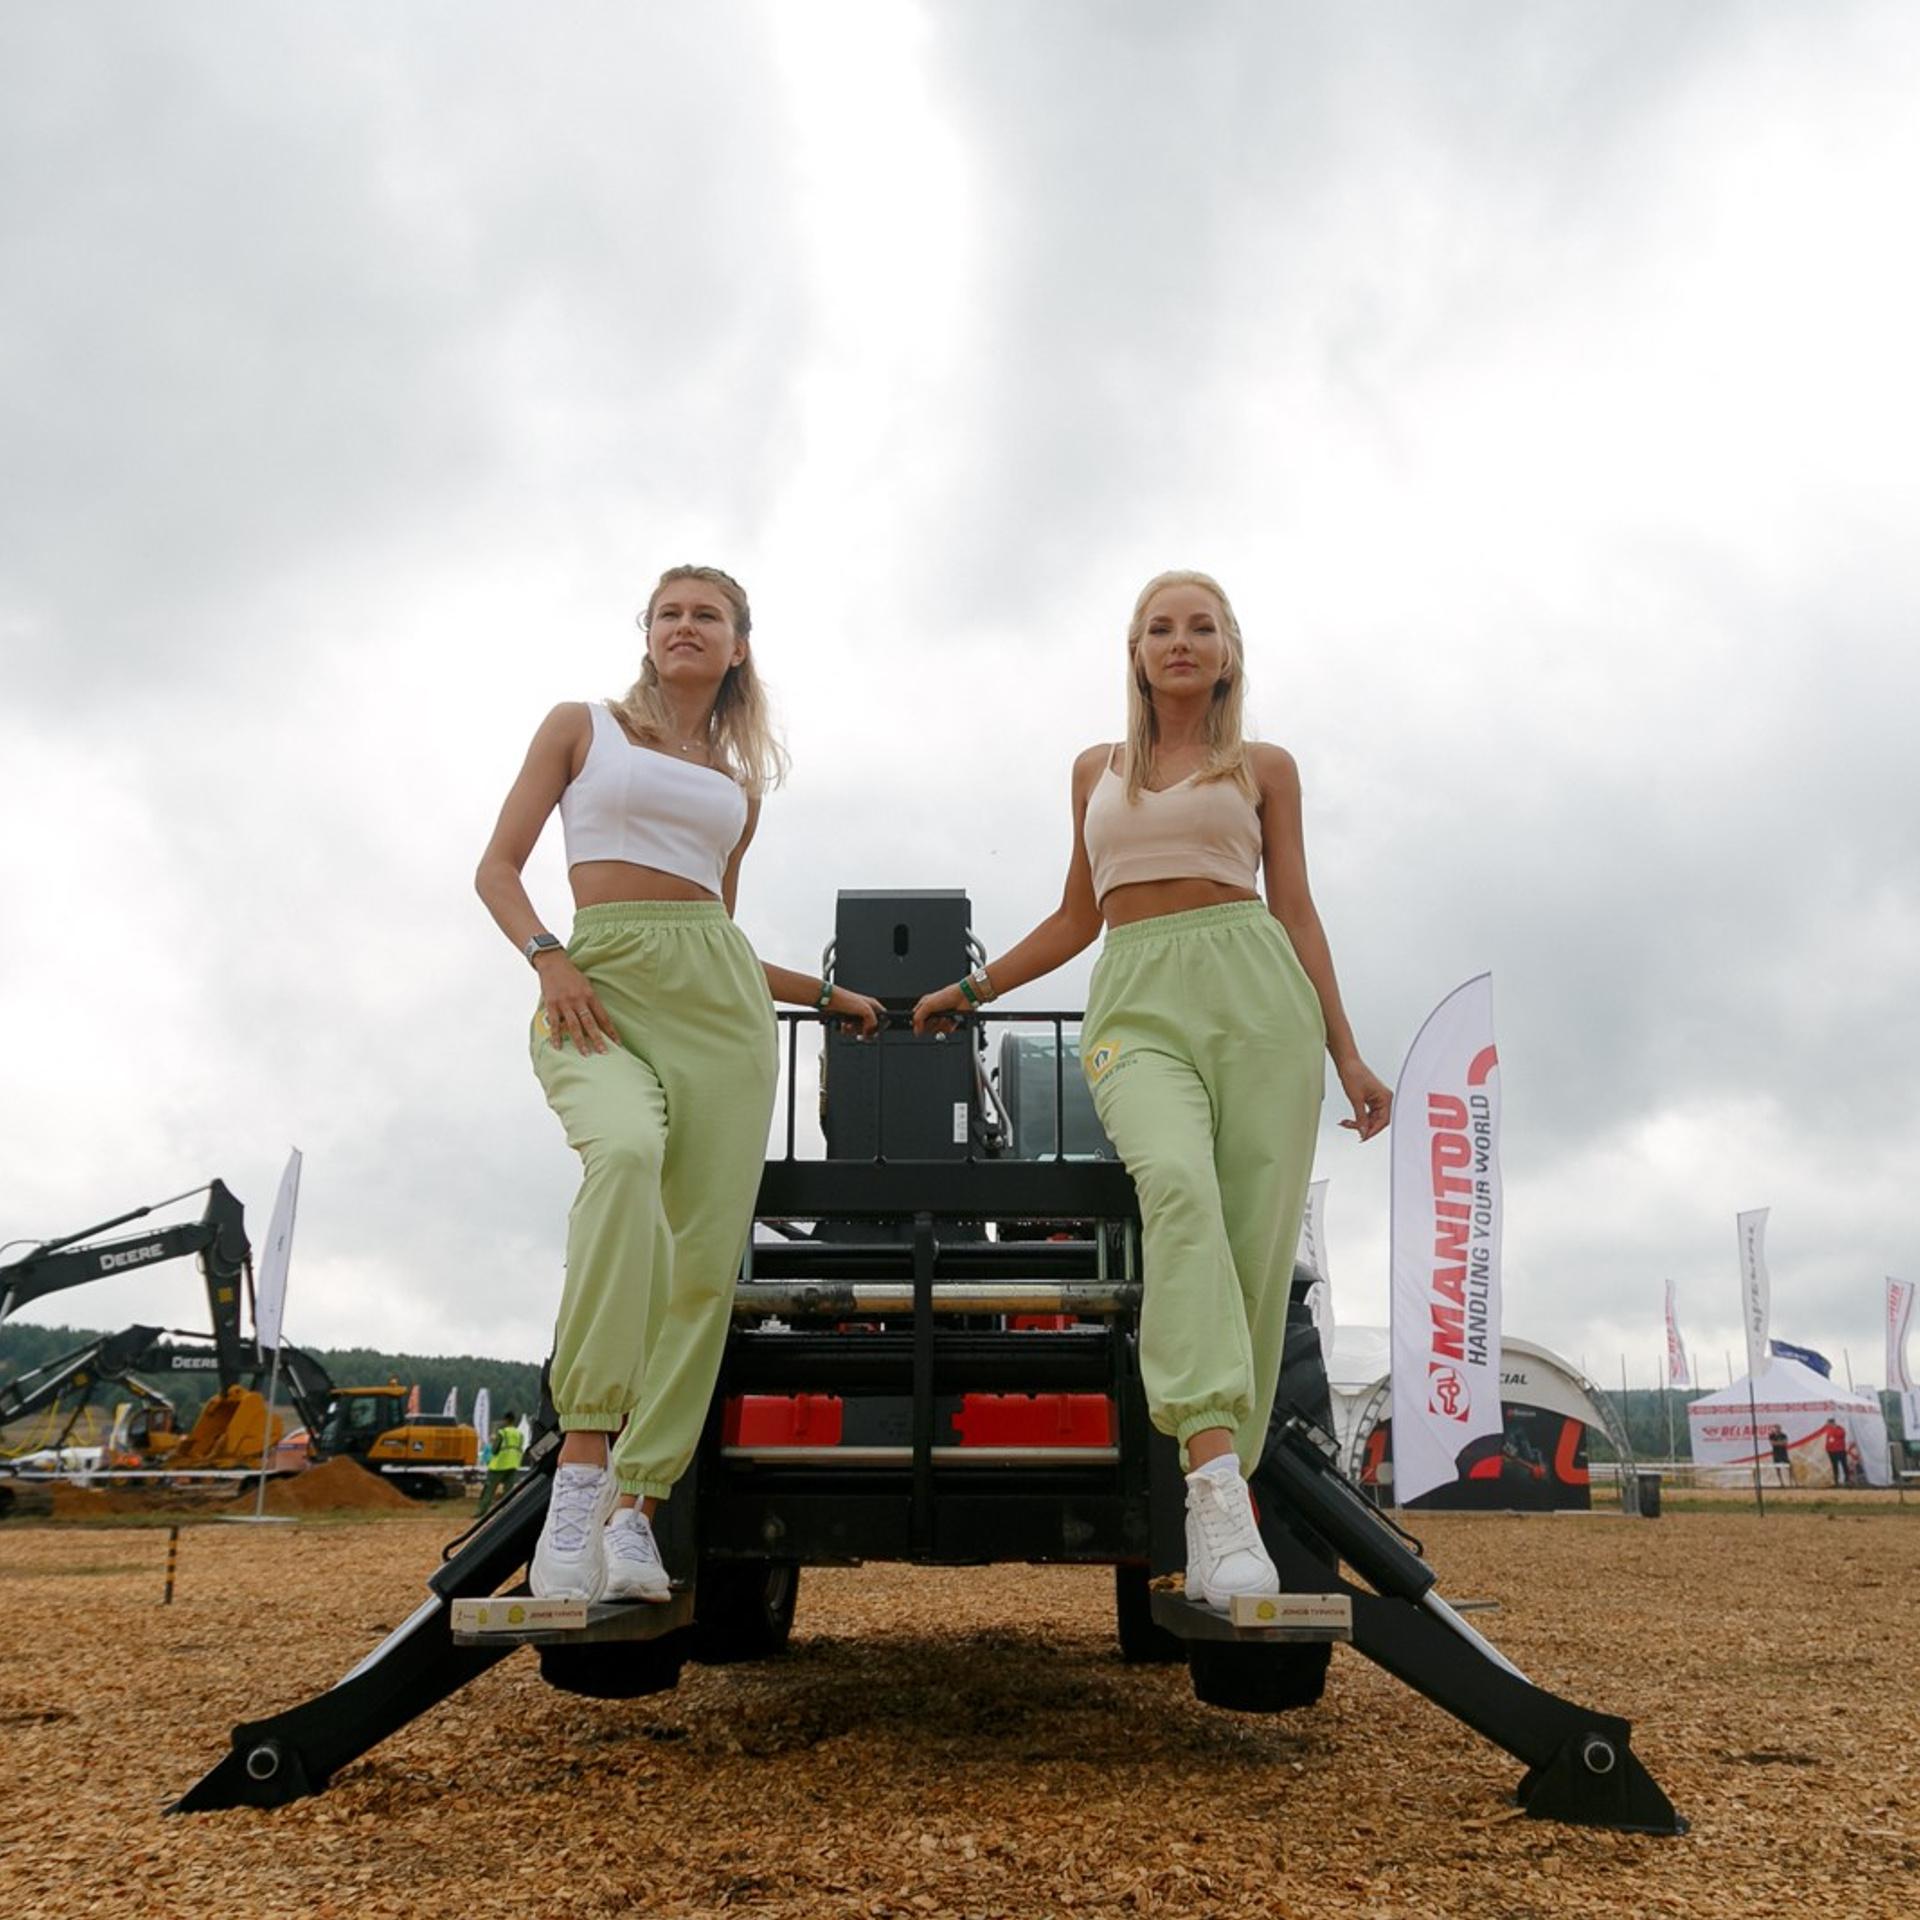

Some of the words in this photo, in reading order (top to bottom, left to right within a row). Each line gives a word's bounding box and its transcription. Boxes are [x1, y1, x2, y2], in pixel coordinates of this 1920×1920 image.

[1469, 1094, 1492, 1173] WORLD
[1427, 1092, 1473, 1361] MANITOU
[1472, 1180, 1493, 1240] YOUR
[100, 1243, 165, 1271] DEERE
[1468, 1246, 1490, 1366] HANDLING
